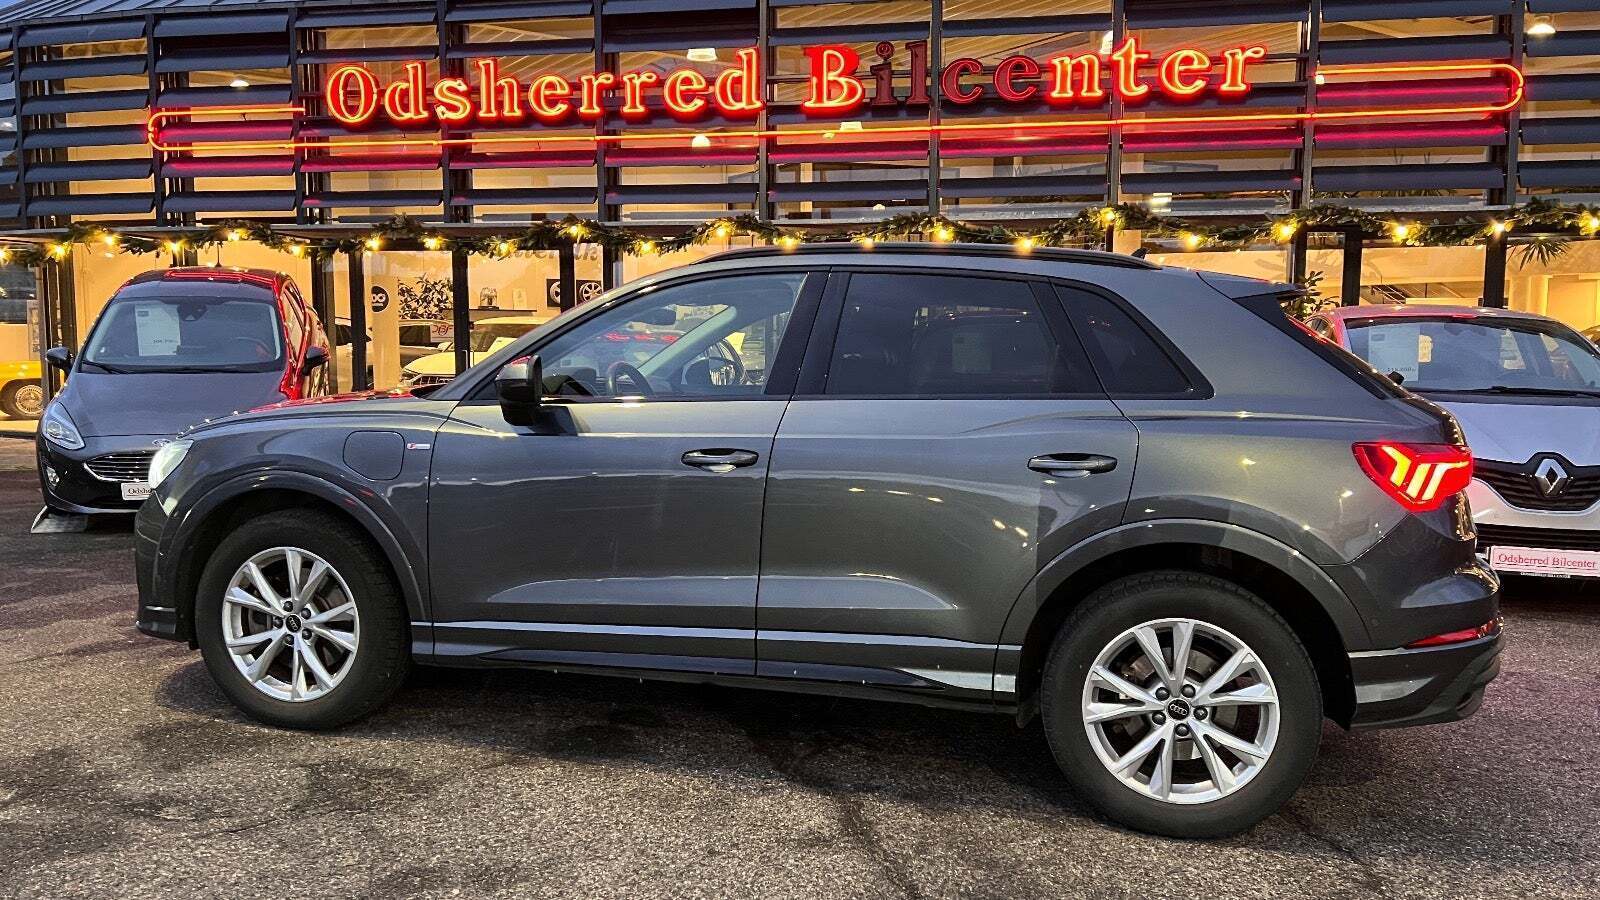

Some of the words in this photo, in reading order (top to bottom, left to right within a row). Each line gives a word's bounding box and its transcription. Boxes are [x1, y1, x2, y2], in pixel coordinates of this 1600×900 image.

[326, 46, 764, 124] Odsherred
[802, 36, 1267, 112] Bilcenter
[1498, 553, 1550, 566] Odsherred
[1551, 556, 1598, 569] Bilcenter
